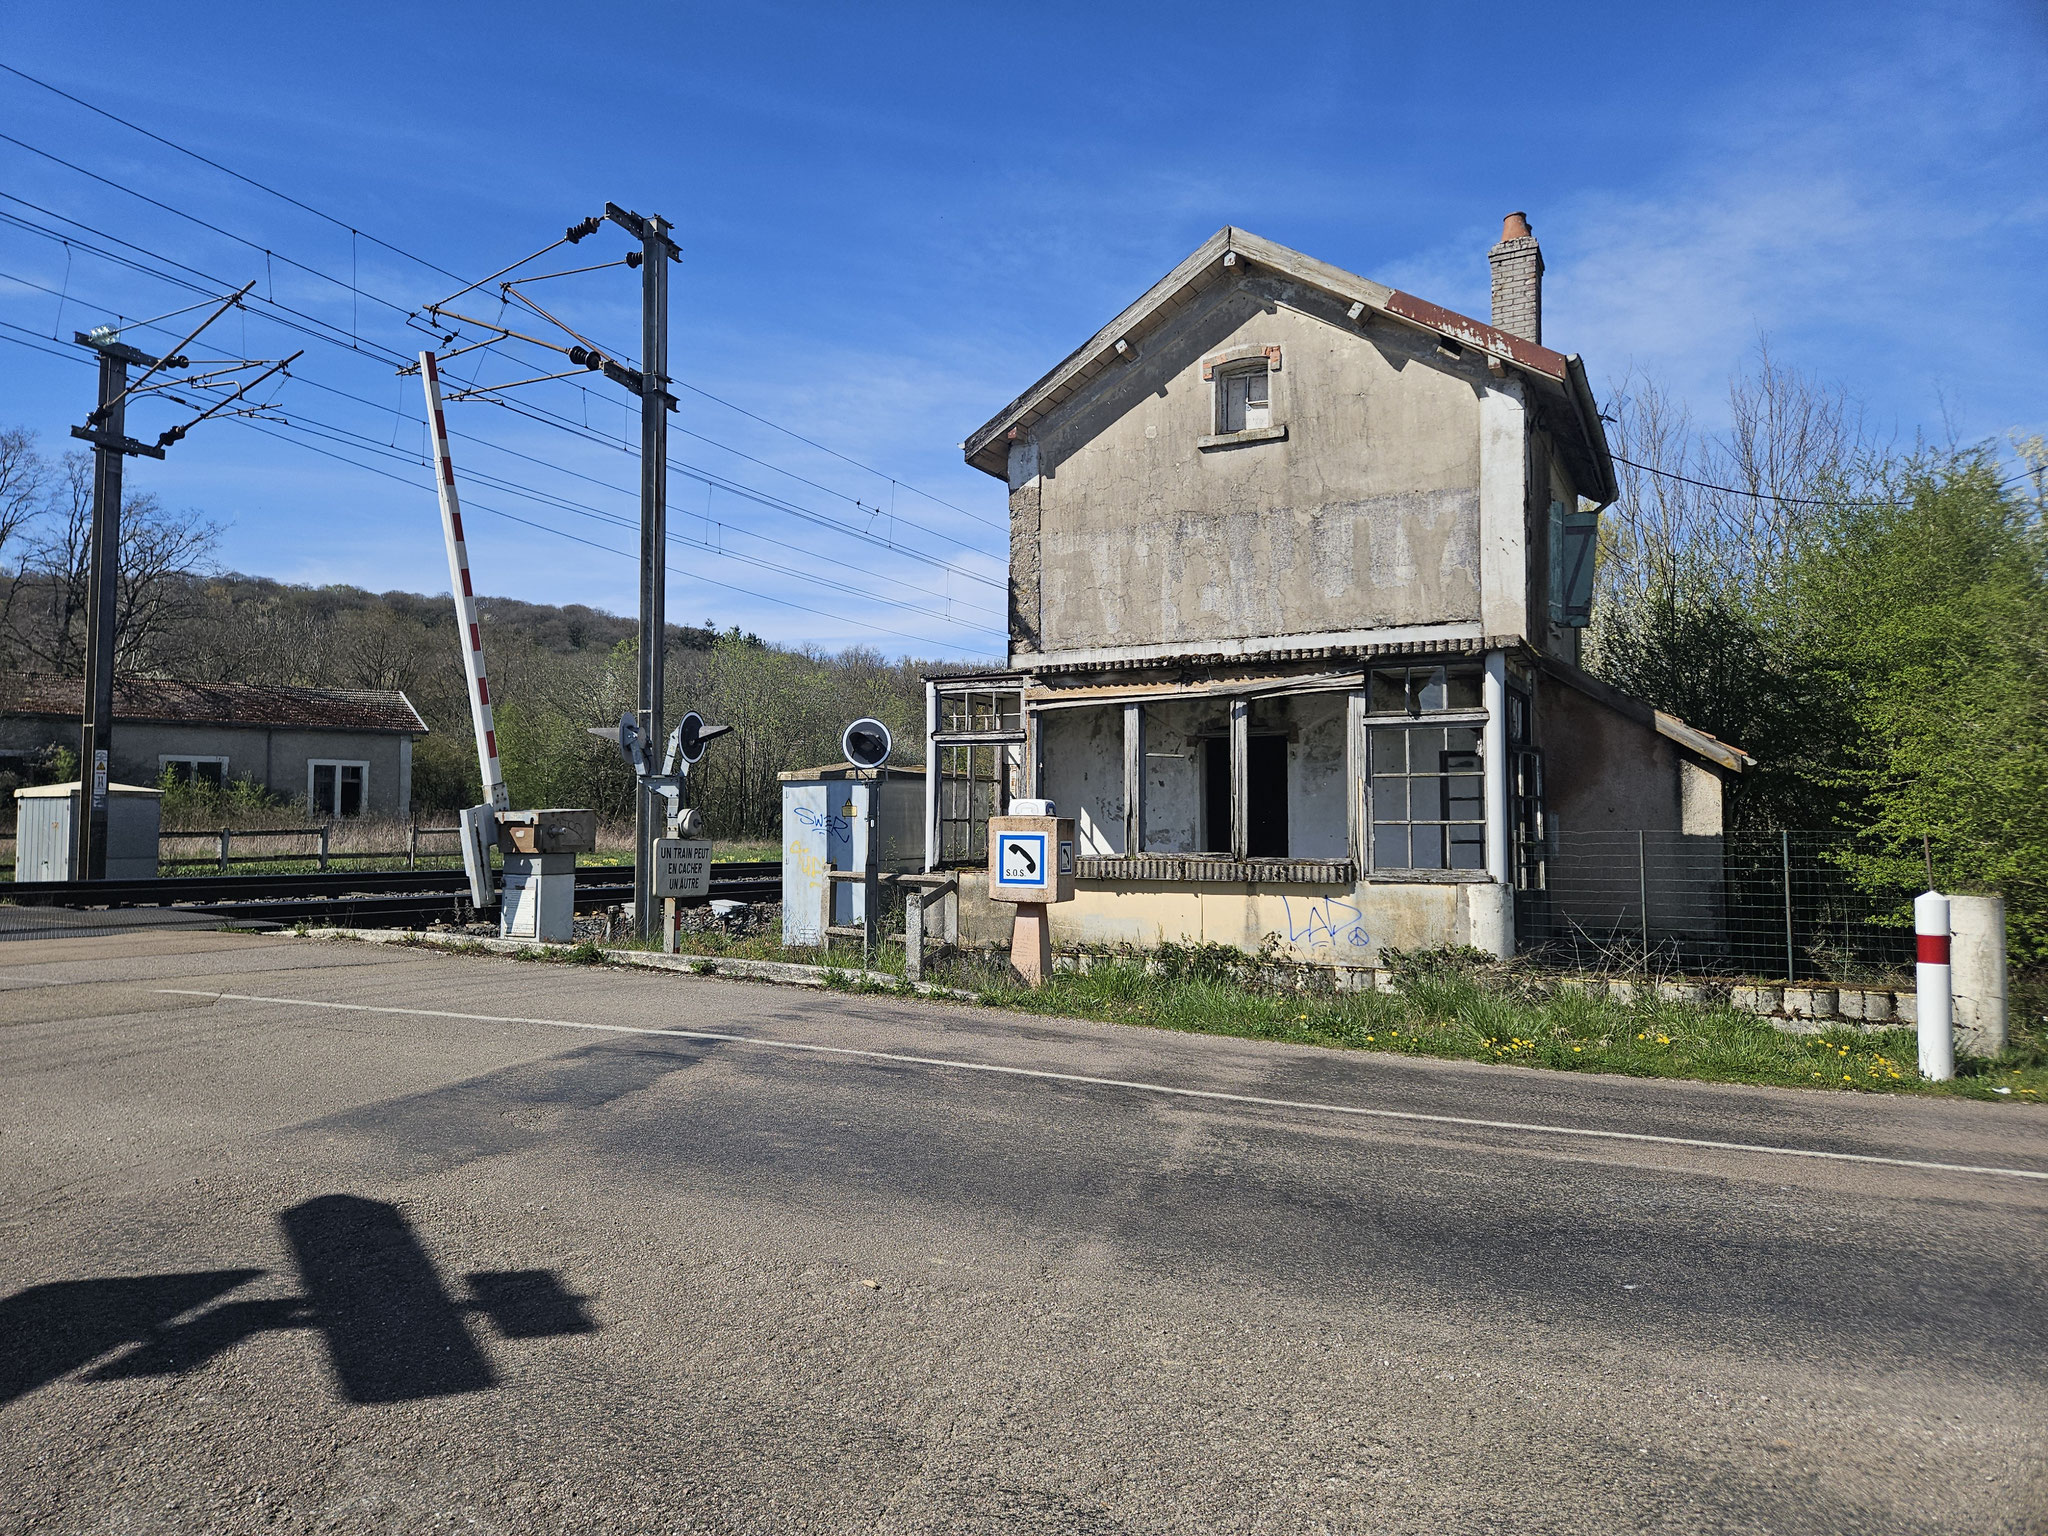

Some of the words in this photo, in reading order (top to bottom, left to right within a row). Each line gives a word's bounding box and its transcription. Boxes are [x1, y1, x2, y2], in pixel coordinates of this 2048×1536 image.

[661, 847, 672, 859] UN
[674, 847, 693, 859] TRAIN
[694, 848, 710, 859] PEUT
[668, 863, 678, 875] EN
[679, 862, 703, 875] CACHER
[1005, 868, 1027, 878] S.O.S.
[669, 878, 679, 890] UN
[680, 877, 699, 890] AUTRE
